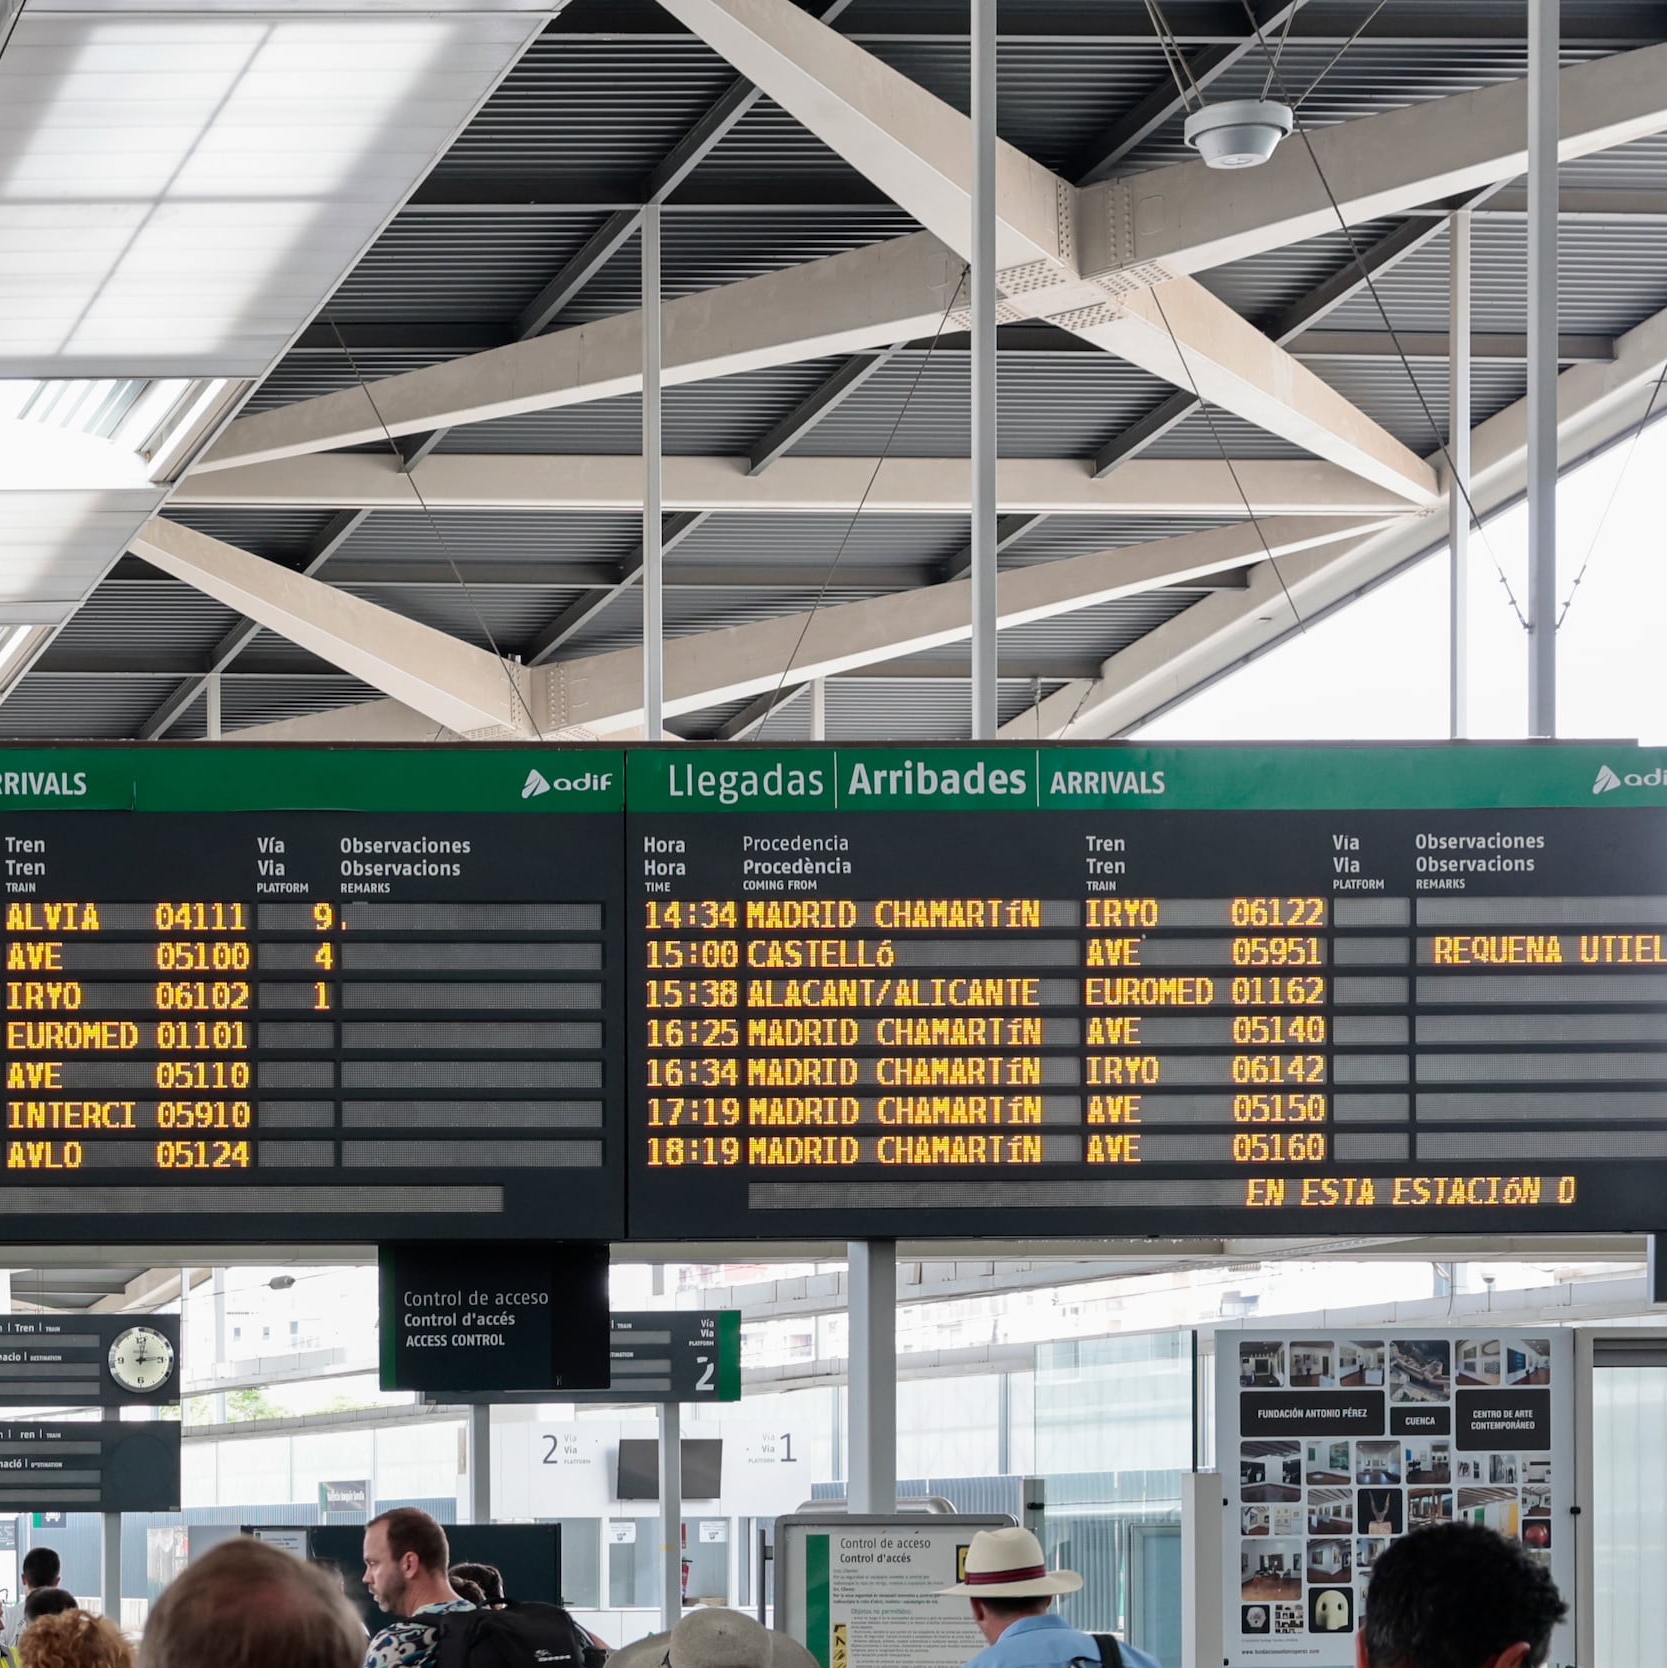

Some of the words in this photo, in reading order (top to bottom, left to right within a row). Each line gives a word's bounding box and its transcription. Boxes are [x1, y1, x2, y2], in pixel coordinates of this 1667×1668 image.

[553, 773, 613, 791] adif
[670, 763, 823, 804] Llegadas
[848, 760, 1026, 795] Arribades
[1050, 771, 1165, 794] ARRIVALS
[743, 835, 848, 851] Procedencia
[744, 857, 851, 874] Procedència
[743, 880, 784, 890] COMING
[788, 880, 817, 890] FROM
[5, 902, 101, 931] ALVIA
[154, 902, 246, 931] 04111
[312, 902, 335, 931] 9
[648, 940, 740, 969] 15:00
[1085, 938, 1138, 967] AVE
[1231, 937, 1319, 966] 05951
[1433, 936, 1563, 964] REQUENA
[6, 1020, 140, 1050] EUROMED
[155, 1021, 247, 1051] 01101
[1246, 1178, 1287, 1207] EN
[1301, 1177, 1375, 1207] ESTA
[1258, 1407, 1304, 1418] FUNDACIÓN
[1305, 1409, 1340, 1418] ANTONIO
[1342, 1407, 1367, 1418] PÉREZ
[1405, 1417, 1435, 1425] CUENCA
[1473, 1410, 1502, 1418] CENTRO
[1503, 1410, 1513, 1418] DE
[1514, 1410, 1533, 1418] ARTE
[1471, 1420, 1535, 1430] CONTEMPORÁNEO
[542, 1434, 558, 1464] 2
[780, 1433, 797, 1462] 1
[840, 1538, 876, 1549] Control
[880, 1538, 893, 1549] de
[897, 1539, 931, 1549] acceso
[840, 1553, 874, 1563] Control
[877, 1553, 911, 1563] d'accés
